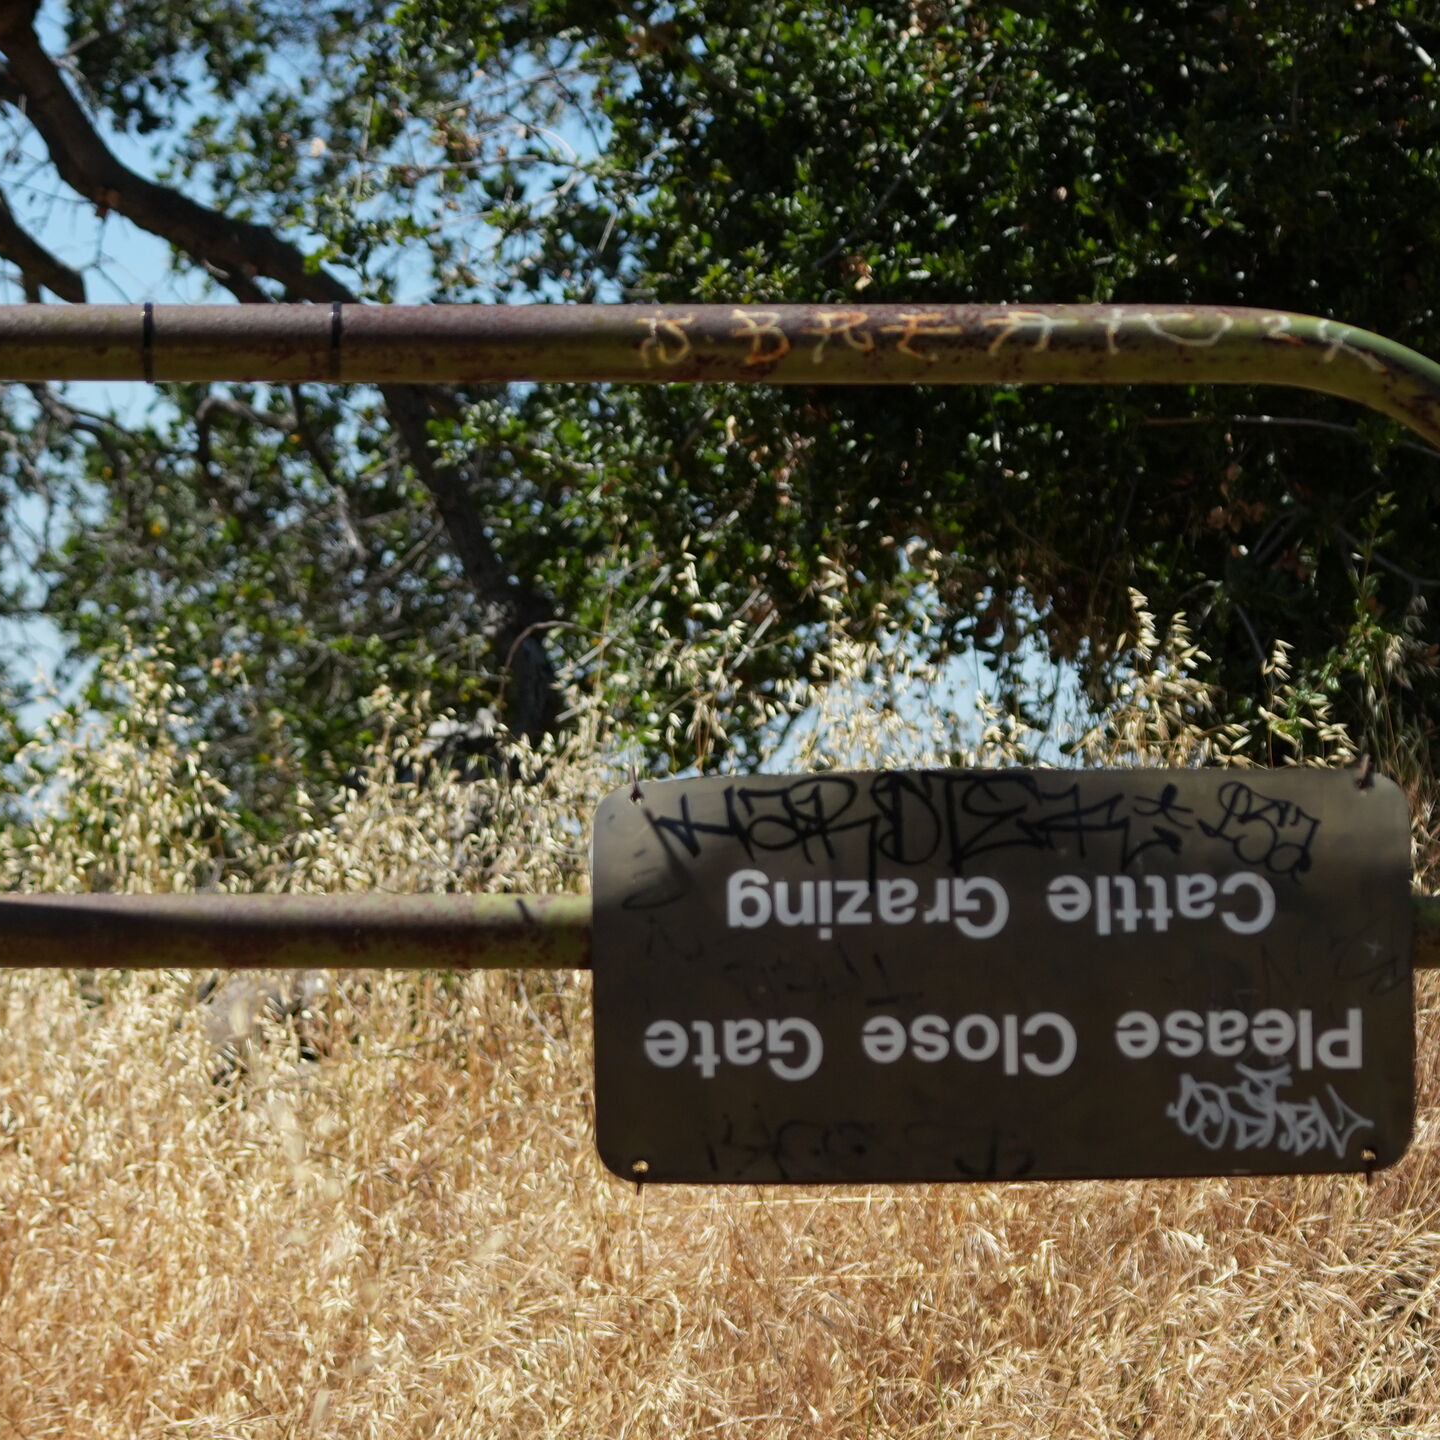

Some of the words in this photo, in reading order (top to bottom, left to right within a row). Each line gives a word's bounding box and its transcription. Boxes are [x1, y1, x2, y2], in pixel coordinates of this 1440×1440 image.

[727, 869, 1008, 939] Grazing
[1048, 872, 1275, 934] Cattle
[645, 1018, 823, 1080] Gate
[863, 1013, 1077, 1075] Close
[1116, 1009, 1362, 1070] Please
